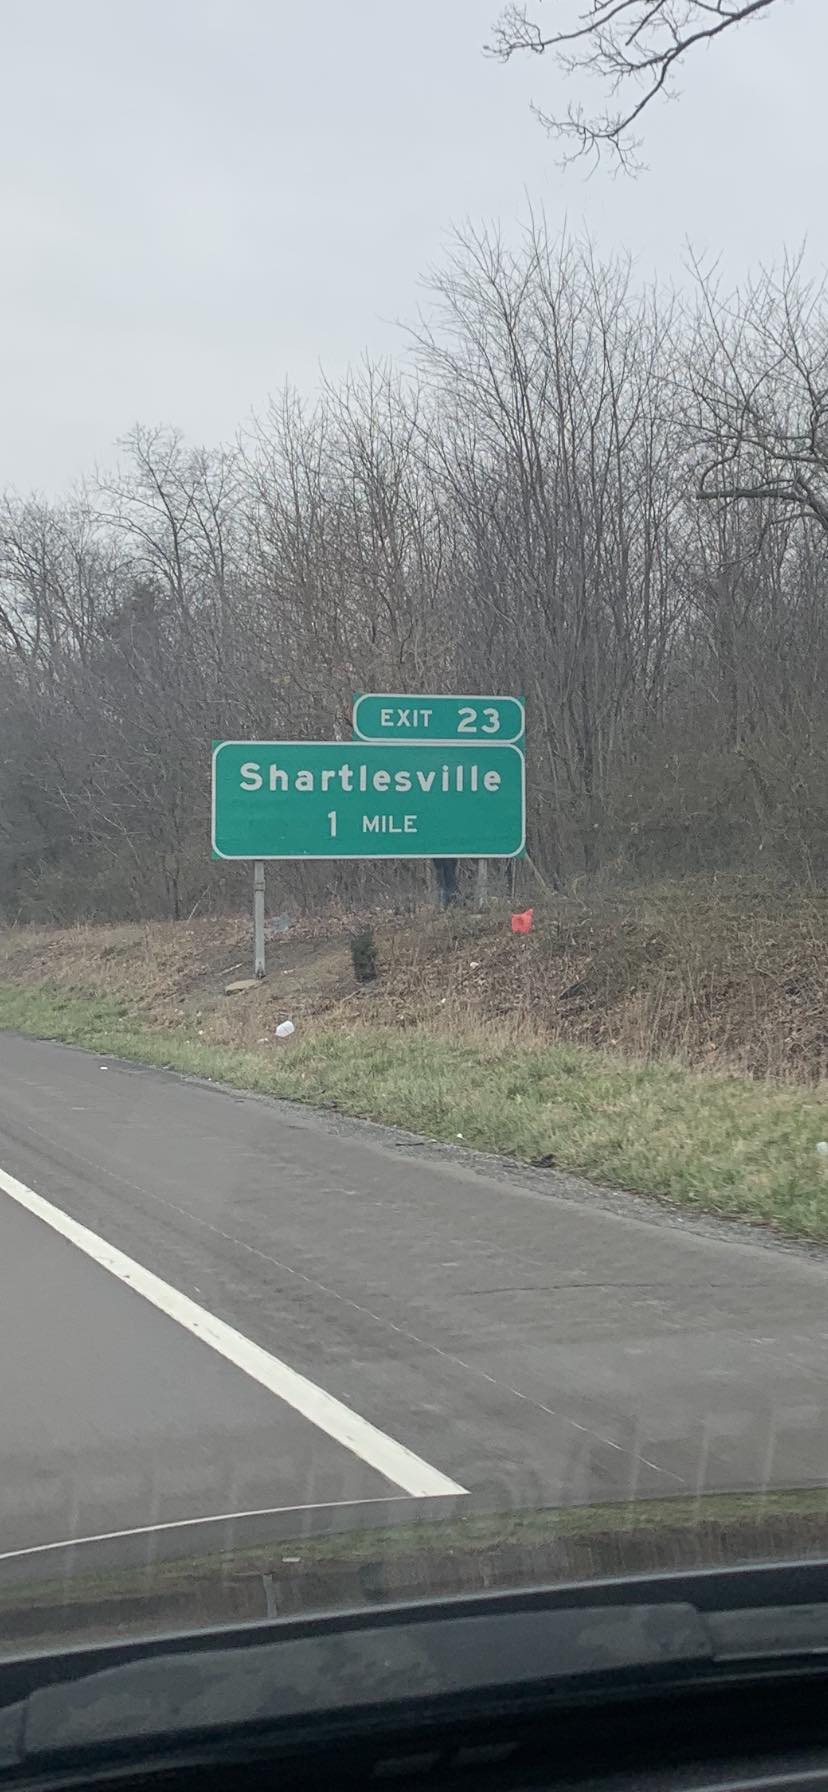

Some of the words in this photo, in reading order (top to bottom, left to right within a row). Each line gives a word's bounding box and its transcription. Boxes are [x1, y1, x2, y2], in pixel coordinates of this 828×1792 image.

[380, 709, 433, 728] EXIT
[457, 707, 501, 733] 23
[240, 762, 502, 792] Shartlesville
[328, 811, 337, 837] 1
[362, 815, 418, 833] MILE
